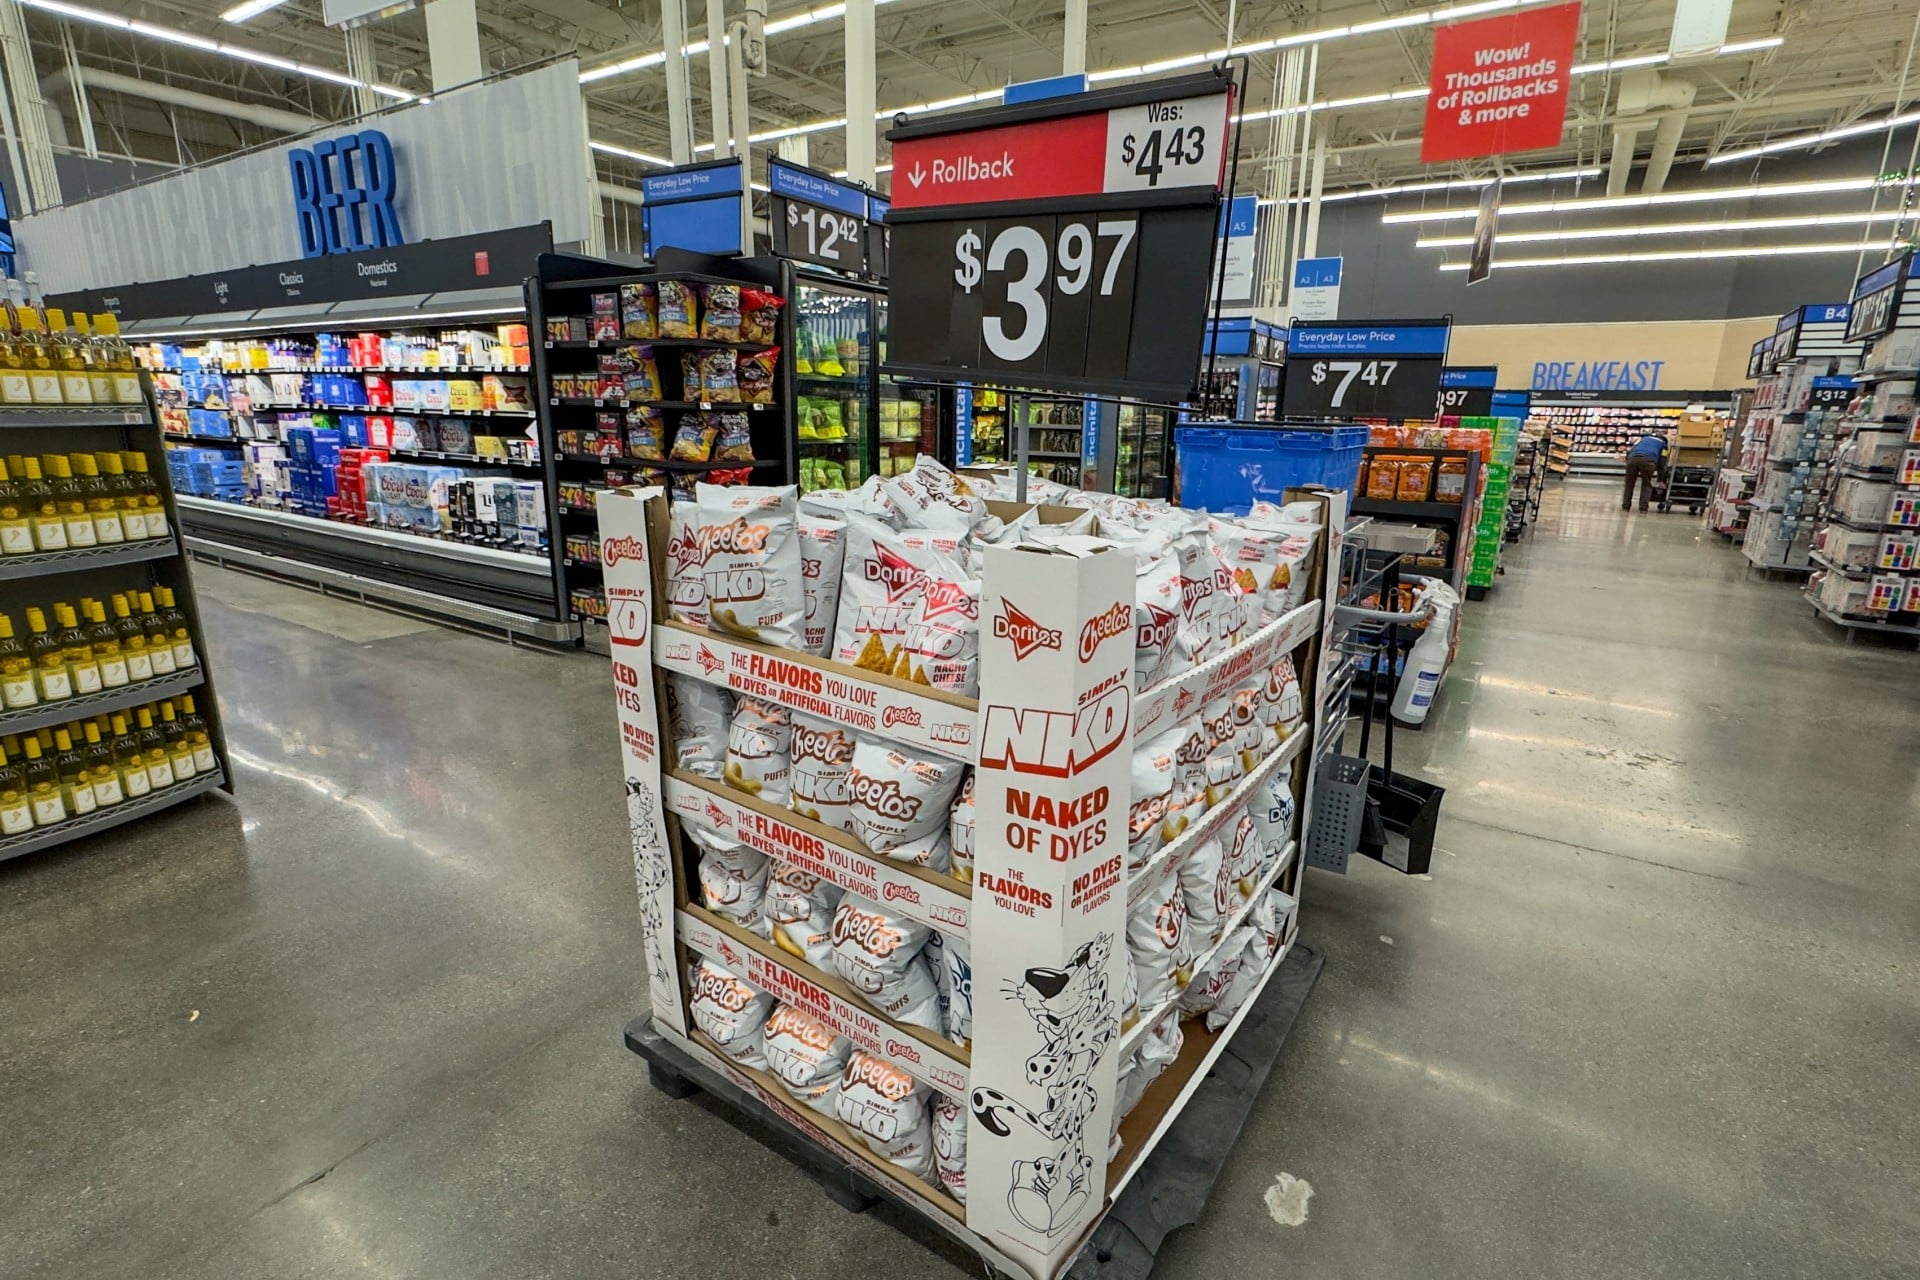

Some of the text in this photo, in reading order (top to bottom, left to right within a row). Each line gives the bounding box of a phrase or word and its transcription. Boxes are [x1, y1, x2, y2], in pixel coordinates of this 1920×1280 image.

[1475, 43, 1530, 66] Wow!
[1445, 59, 1556, 90] Thousands
[1437, 80, 1558, 110] of Rollbacks
[1147, 103, 1184, 122] Was:
[1458, 103, 1530, 126] & more
[932, 151, 1014, 184] Rollback
[288, 129, 404, 259] BEER
[648, 174, 710, 190] Everyday Low Price
[778, 171, 809, 190] Everyday
[810, 180, 823, 192] Low
[824, 184, 840, 197] Price
[1233, 222, 1246, 231] A5
[280, 272, 304, 286] Classics
[358, 259, 398, 276] Domestics
[214, 282, 230, 295] Light
[1824, 308, 1848, 320] B4
[1298, 332, 1396, 343] Everyday Low Price
[1451, 372, 1466, 380] Price
[1532, 361, 1664, 390] BREAKFAST
[956, 382, 966, 466] ncinitas
[604, 536, 642, 567] Cheetos
[608, 588, 644, 597] SIMPLY
[608, 598, 648, 647] KD
[758, 612, 784, 626] PUFFS
[994, 614, 1062, 650] Doritos
[1078, 602, 1132, 664] Cheetos
[612, 661, 638, 688] KED
[731, 652, 877, 708] THE FLAVORS YOU LOVE
[932, 672, 966, 682] CHEESE
[934, 664, 967, 673] NACHO
[614, 685, 640, 713] YES
[1078, 668, 1128, 706] SIMPLY
[728, 673, 876, 730] NO DYES OR ARTIFICIAL FLAVORS
[882, 706, 922, 728] Cheetos
[623, 722, 654, 746] NO DYES
[930, 724, 971, 744] NKD
[980, 685, 1130, 778] NKD
[764, 768, 789, 782] PUFFS
[1006, 786, 1109, 829] NAKED
[867, 820, 908, 834] SIMPLY
[737, 810, 876, 882] THE FLAVORS YOU LOVE
[1006, 818, 1107, 862] OF DYES
[738, 829, 751, 846] NO
[752, 835, 775, 856] DYES
[786, 850, 838, 883] ARTIFICIAL
[840, 872, 878, 900] FLAVORS
[1008, 868, 1024, 882] THE
[1072, 855, 1122, 896] NO DYES
[882, 882, 921, 905] Cheetos
[980, 872, 1052, 909] FLAVORS
[1071, 874, 1120, 908] OR ARTIFICIAL
[1082, 890, 1110, 915] FLAVORS
[930, 904, 967, 927] NKD
[994, 896, 1036, 918] YOU LOVE
[832, 905, 901, 958] Cheetos
[748, 952, 880, 1037] THE FLAVORS YOU LOVE
[886, 995, 910, 1010] PUFFS
[748, 970, 760, 986] NO
[762, 976, 784, 999] DYES
[794, 997, 843, 1033] ARTIFICIAL
[844, 1025, 882, 1054] FLAVORS
[763, 1002, 838, 1052] Cheetos
[790, 1048, 819, 1062] SIMPLY
[886, 1040, 921, 1063] Cheetos
[842, 1051, 916, 1100] Cheetos
[866, 1100, 898, 1114] SIMPLY
[889, 1142, 914, 1158] PUFFS
